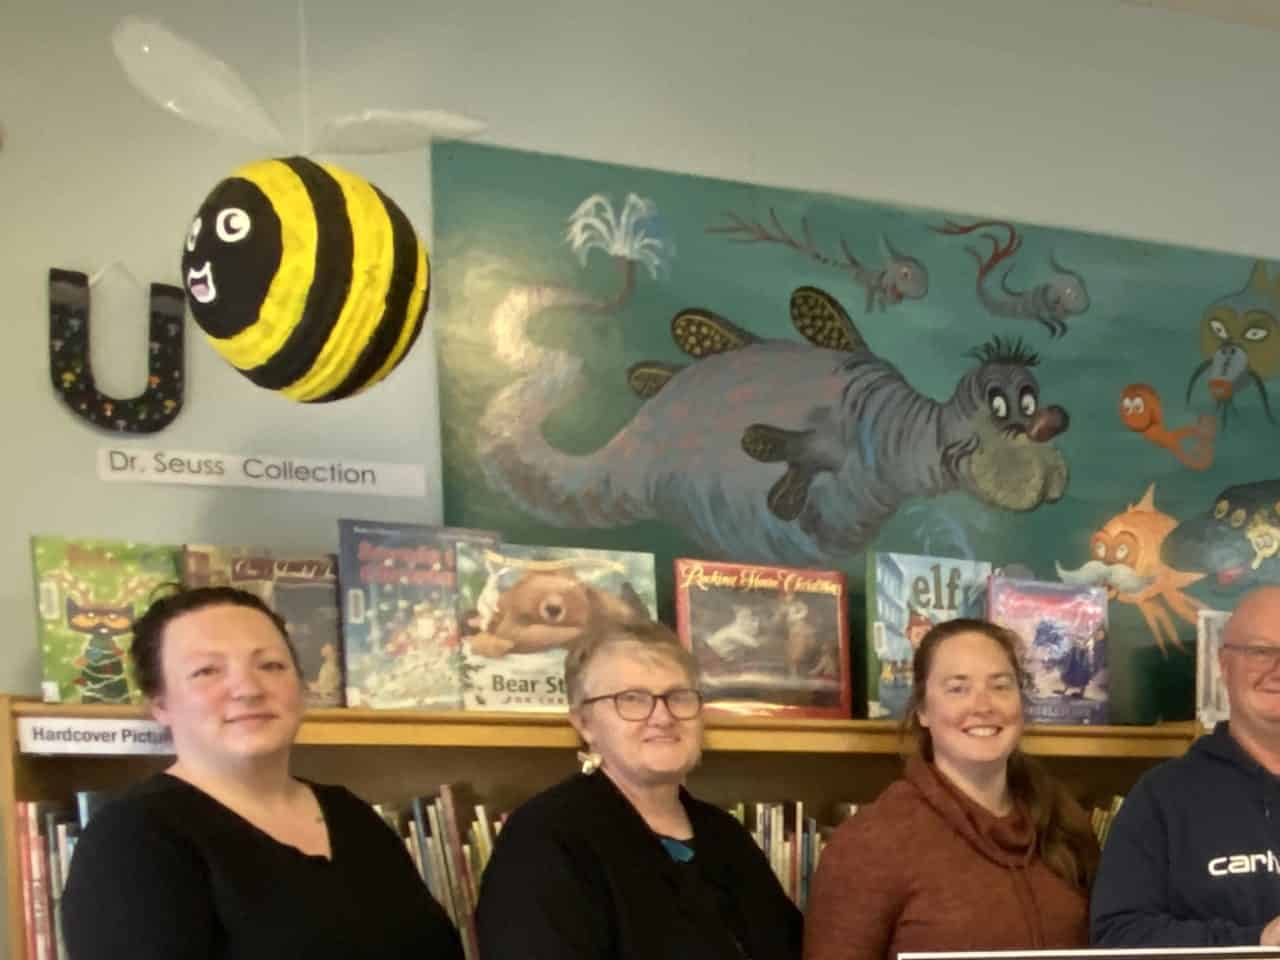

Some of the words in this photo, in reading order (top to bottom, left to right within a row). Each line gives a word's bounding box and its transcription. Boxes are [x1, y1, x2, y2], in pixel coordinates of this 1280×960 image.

[108, 450, 145, 474] Dr.
[154, 452, 226, 476] Seuss
[242, 458, 377, 485] Collection
[912, 561, 961, 611] elf
[492, 674, 537, 692] Bear
[545, 675, 569, 694] St
[31, 725, 118, 743] Hardcover
